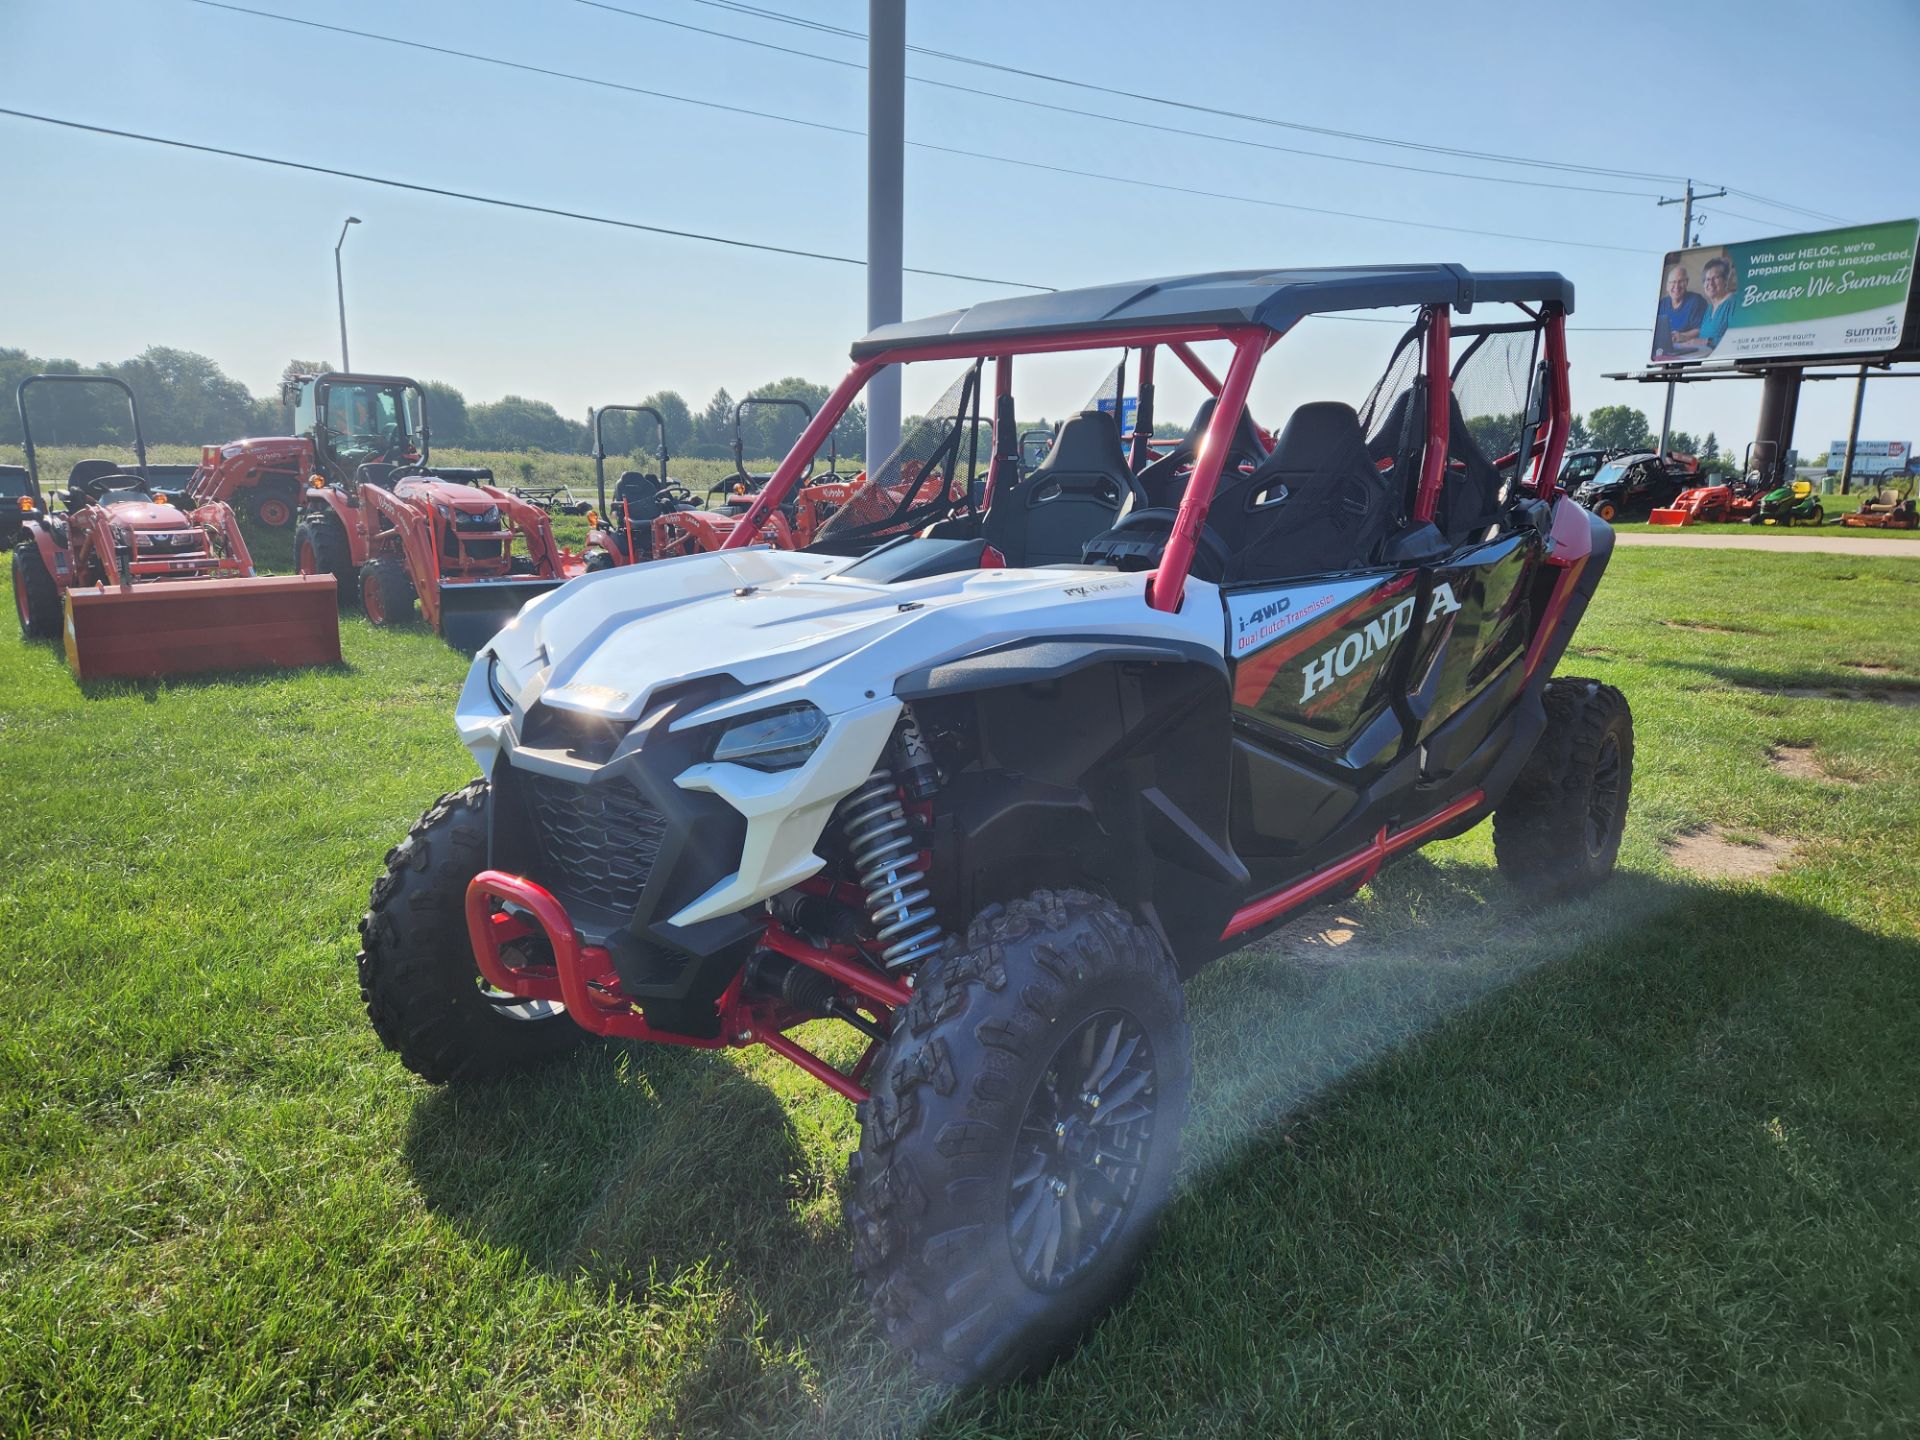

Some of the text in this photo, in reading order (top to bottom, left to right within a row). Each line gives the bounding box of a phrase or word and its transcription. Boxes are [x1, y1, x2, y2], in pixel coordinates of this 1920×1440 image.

[1747, 249, 1911, 278] prepared for the unexpected.
[1750, 253, 1775, 265] With
[1777, 251, 1796, 261] our
[1798, 245, 1841, 259] HELOC,
[1742, 284, 1805, 307] Because
[1807, 274, 1836, 298] We
[1845, 324, 1898, 338] summit
[1872, 335, 1897, 343] UNION
[1761, 341, 1783, 349] CREDIT
[1238, 594, 1335, 650] Dual Clutch Transmission
[1239, 596, 1291, 633] i-4WD
